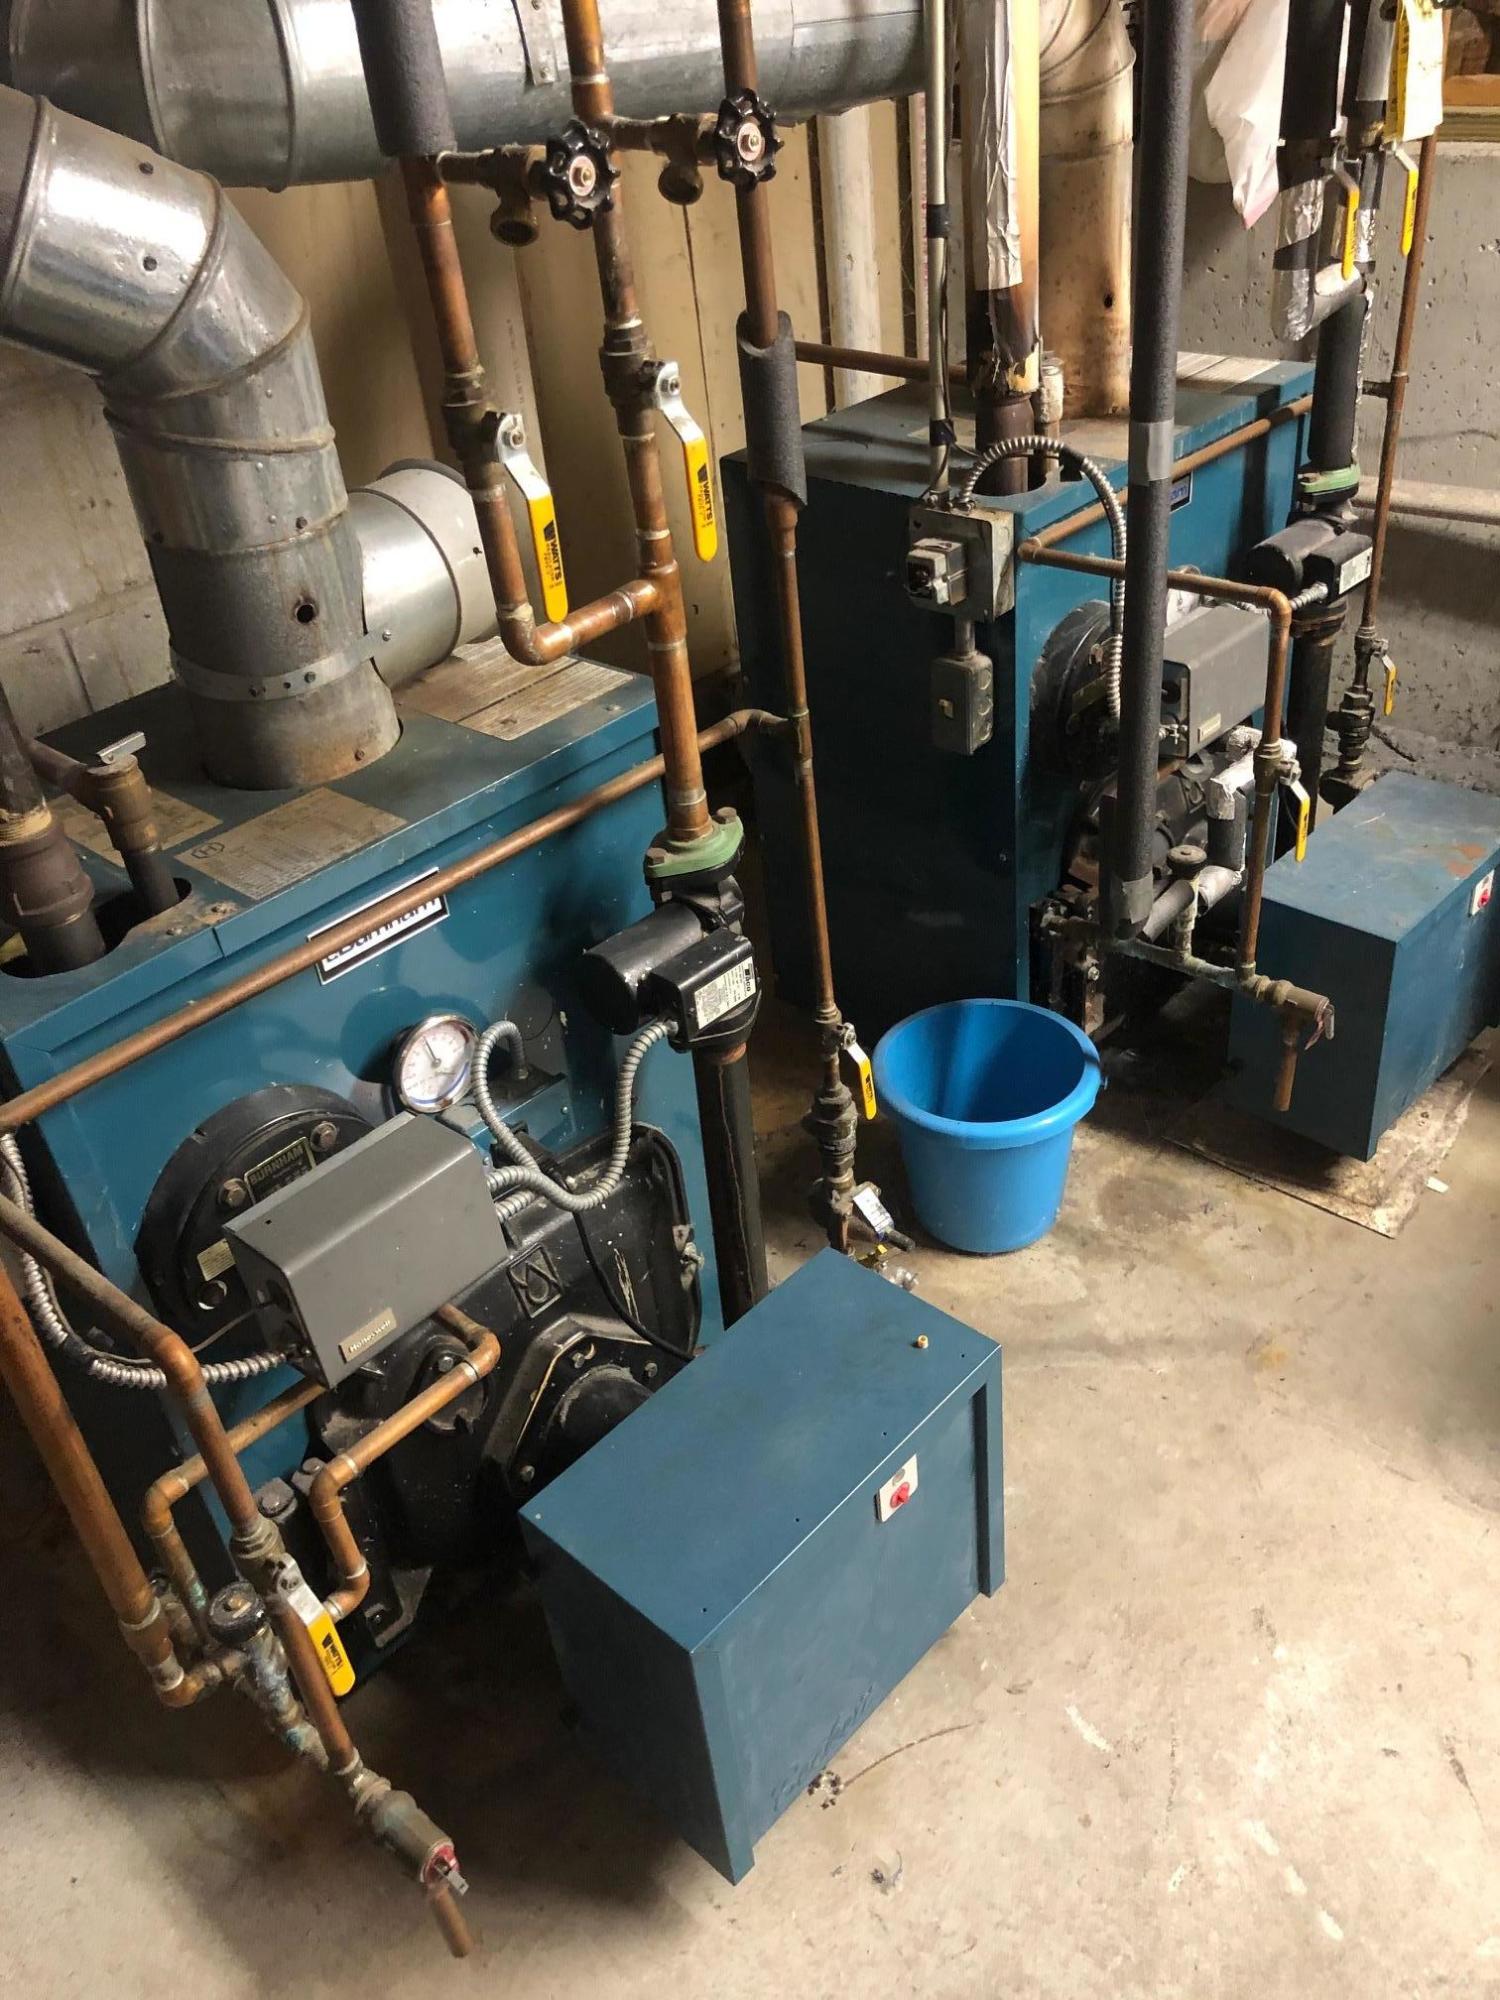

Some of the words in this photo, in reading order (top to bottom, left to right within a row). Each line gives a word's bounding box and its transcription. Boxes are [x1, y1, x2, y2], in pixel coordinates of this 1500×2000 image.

[703, 481, 713, 521] WATTS
[550, 539, 562, 580] WATTS
[249, 1143, 305, 1186] BURNHAM
